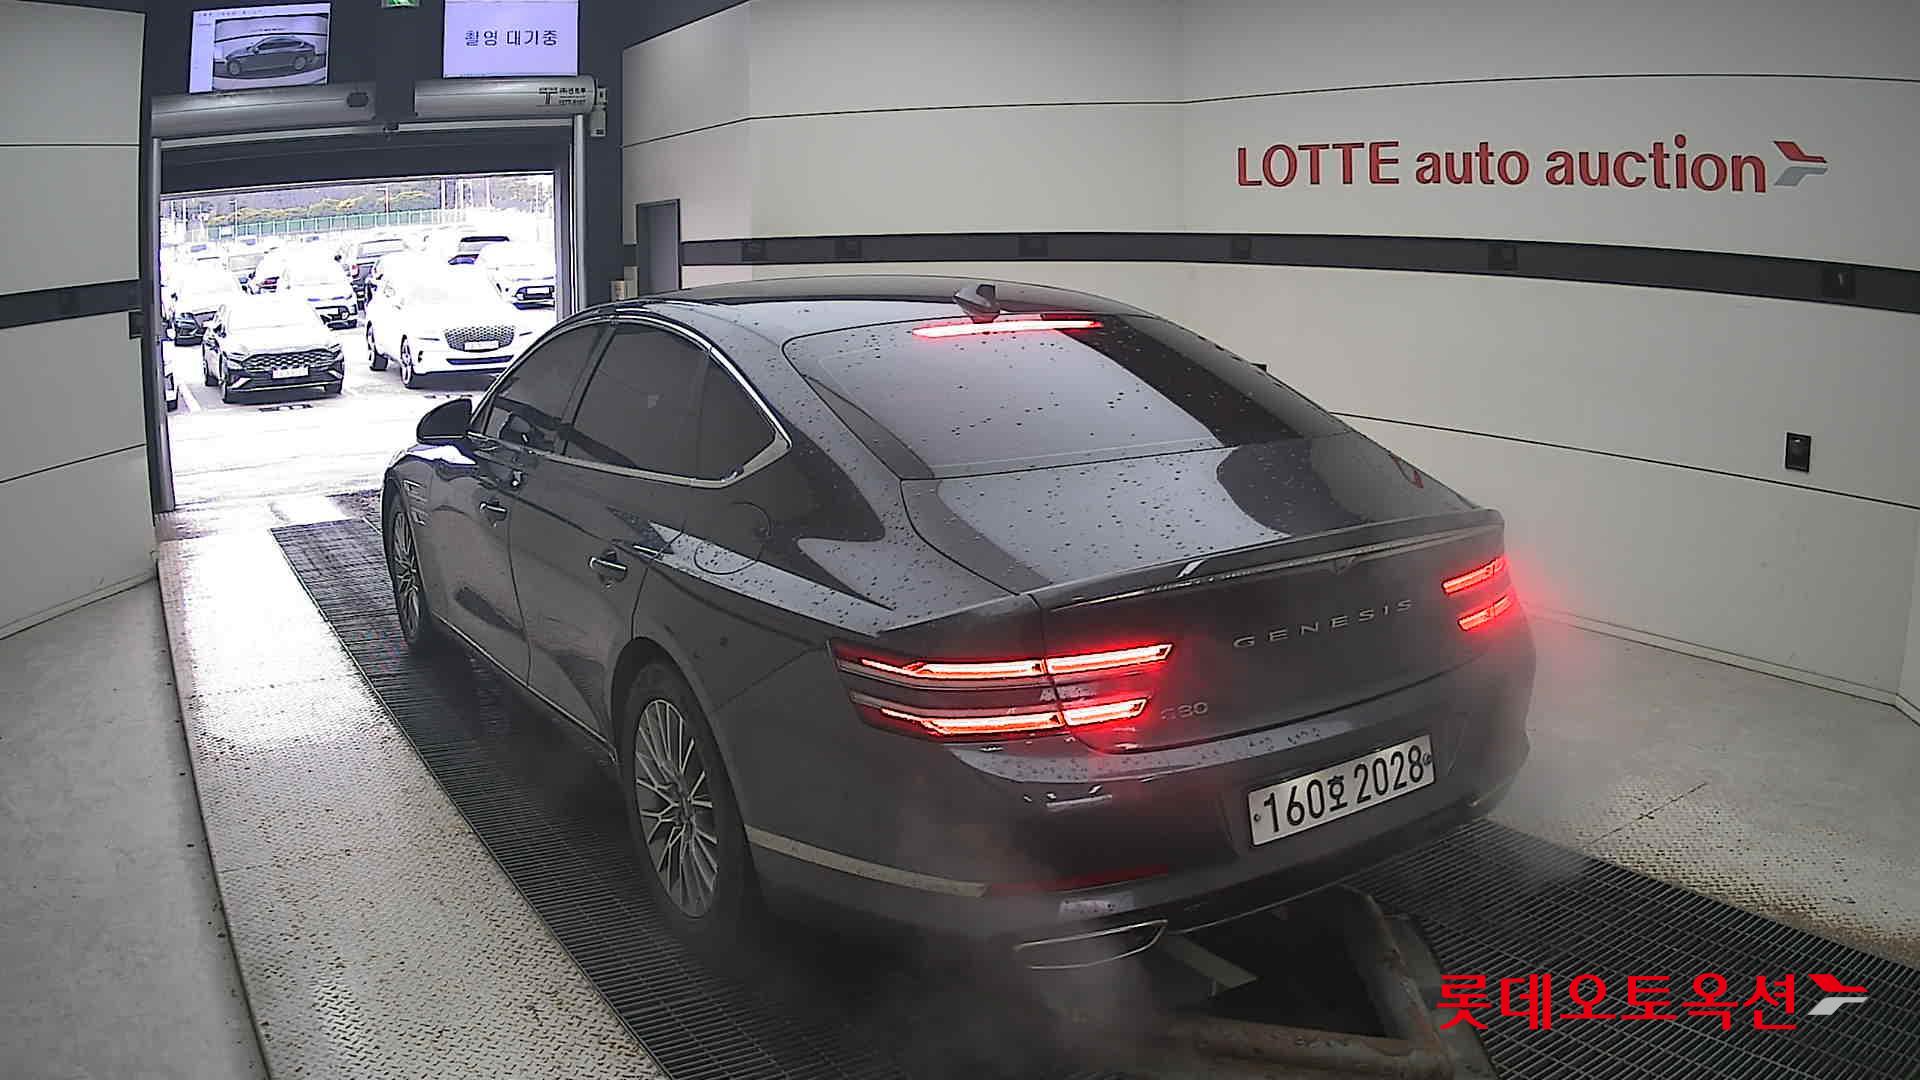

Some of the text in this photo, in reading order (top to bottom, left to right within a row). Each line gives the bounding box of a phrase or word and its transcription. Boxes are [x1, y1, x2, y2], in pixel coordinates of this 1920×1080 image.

[506, 30, 557, 46] 대기중
[1237, 134, 1767, 193] LOTTE auto auction
[1233, 600, 1412, 648] GENESIS
[1263, 745, 1424, 833] 160호 2028
